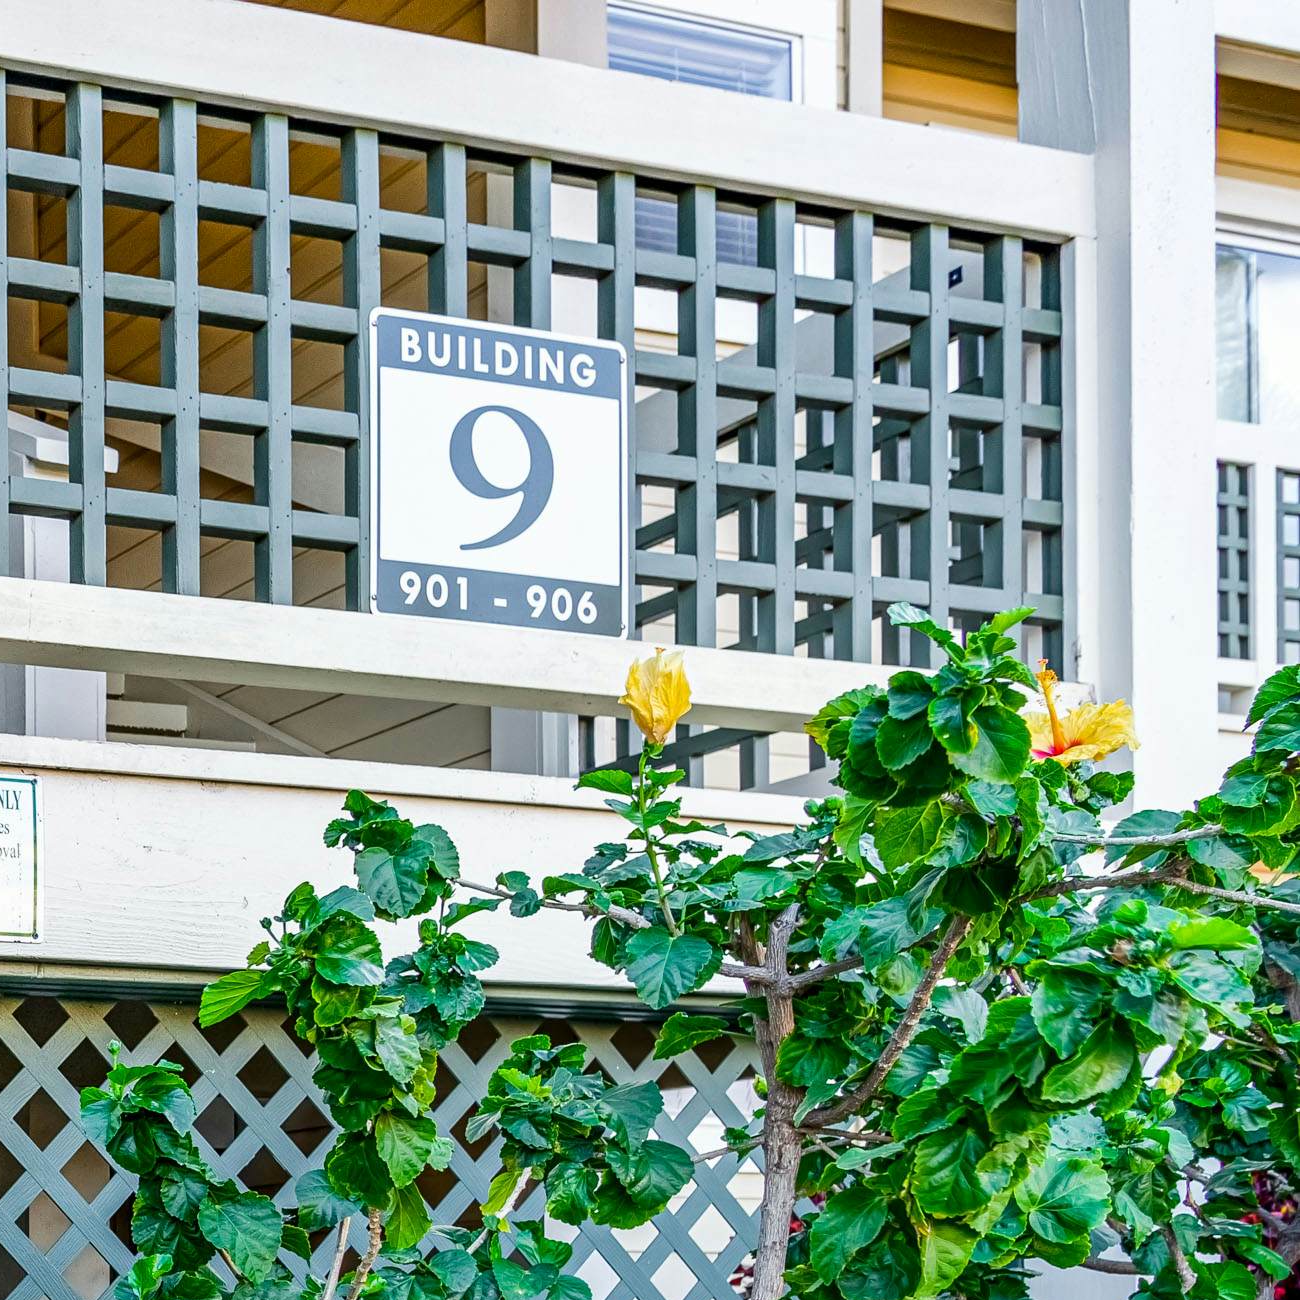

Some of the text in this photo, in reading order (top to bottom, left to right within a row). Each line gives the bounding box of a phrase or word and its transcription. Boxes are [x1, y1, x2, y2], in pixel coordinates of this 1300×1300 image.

[401, 327, 597, 388] BUILDING
[449, 405, 554, 550] 9
[399, 570, 468, 611] 901
[526, 584, 598, 625] 906
